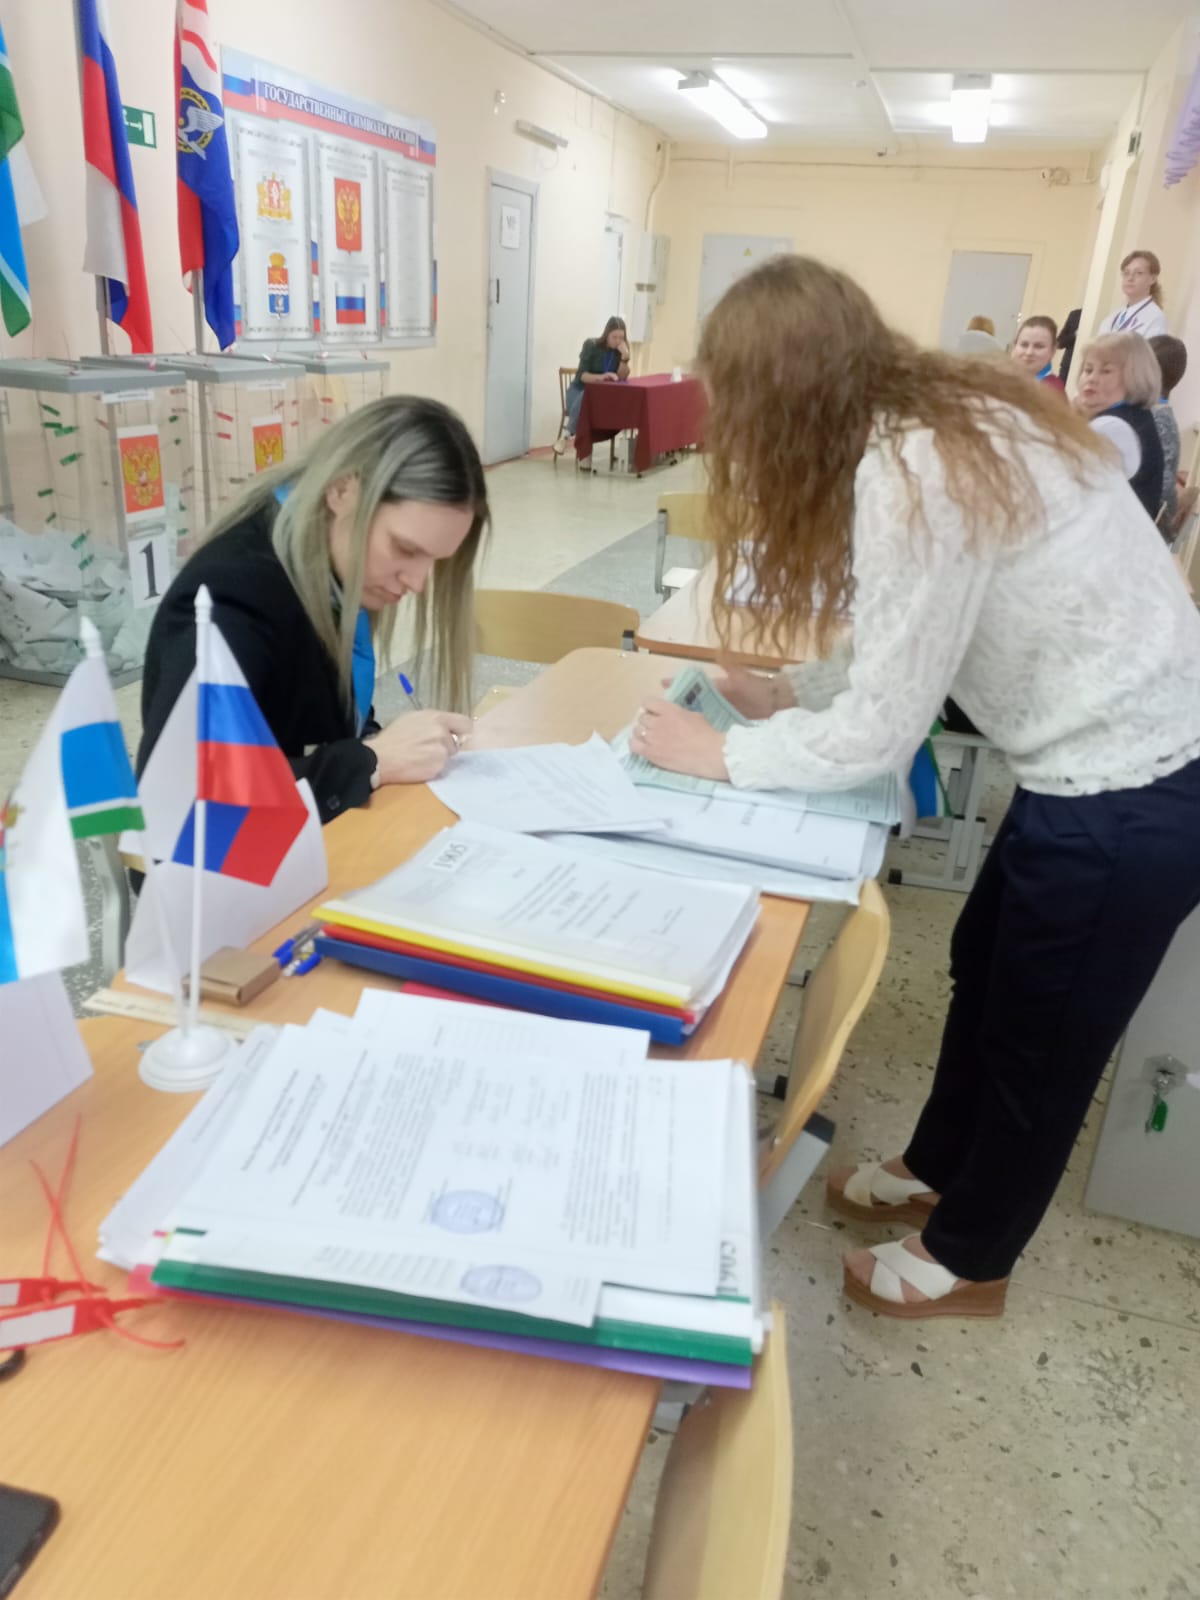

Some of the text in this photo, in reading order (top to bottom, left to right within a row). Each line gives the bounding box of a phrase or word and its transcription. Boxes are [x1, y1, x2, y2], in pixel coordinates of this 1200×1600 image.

[263, 82, 417, 146] ГОСУДАРСТВЕННЫЕ СИМВОЛЫ РОССИИ
[138, 539, 161, 601] 1
[433, 842, 468, 869] 1905
